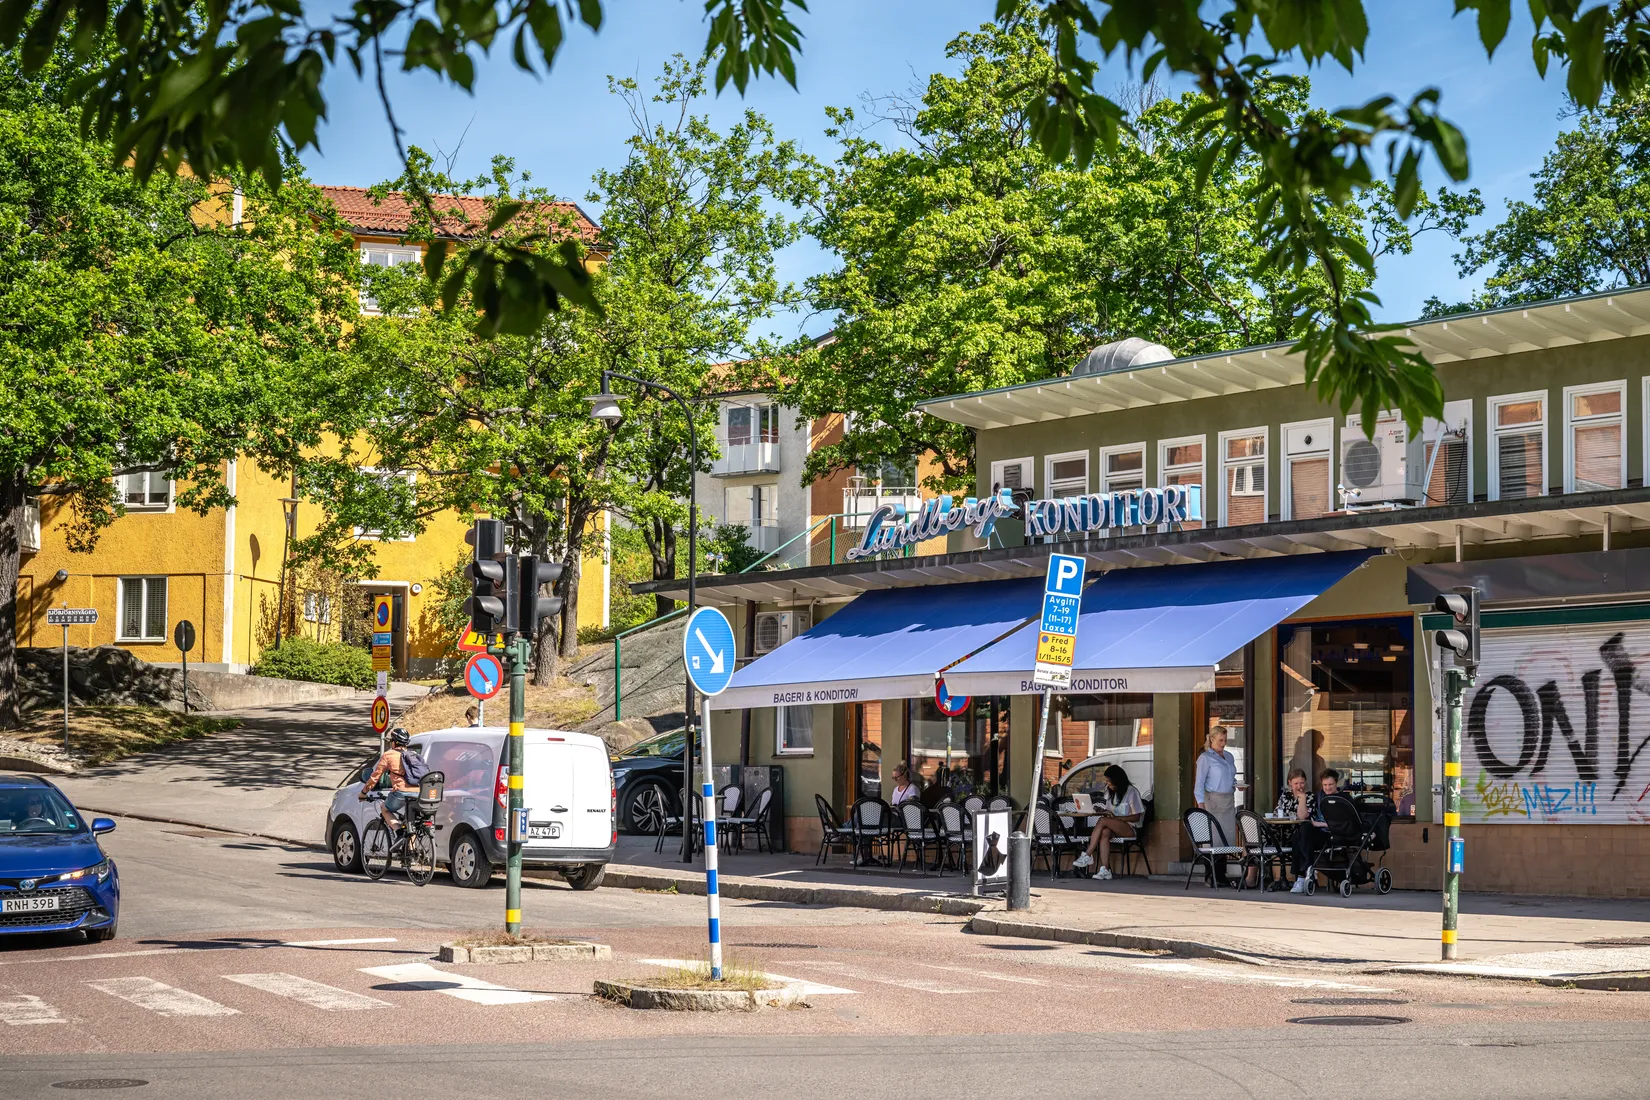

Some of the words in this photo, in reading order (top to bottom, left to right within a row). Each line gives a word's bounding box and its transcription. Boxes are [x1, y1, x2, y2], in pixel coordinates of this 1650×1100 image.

[846, 488, 1016, 560] Lundbergs
[1023, 484, 1202, 537] KONDITORI
[1056, 559, 1078, 590] P
[1049, 596, 1075, 606] Avgift
[1052, 605, 1070, 615] 7-19
[1048, 613, 1072, 624] (11-17)
[1044, 623, 1065, 633] Taxa
[1051, 636, 1069, 645] Fred
[1050, 645, 1067, 654] 8-16
[1039, 653, 1071, 663] 1/11-15/5
[1071, 678, 1128, 690] KONDITORI
[774, 692, 804, 703] BAGERI
[806, 691, 812, 702] &
[814, 688, 859, 701] KONDITORI
[374, 705, 386, 724] 10
[542, 827, 556, 836] 47P
[6, 900, 29, 911] RNH
[32, 898, 54, 910] 39B
